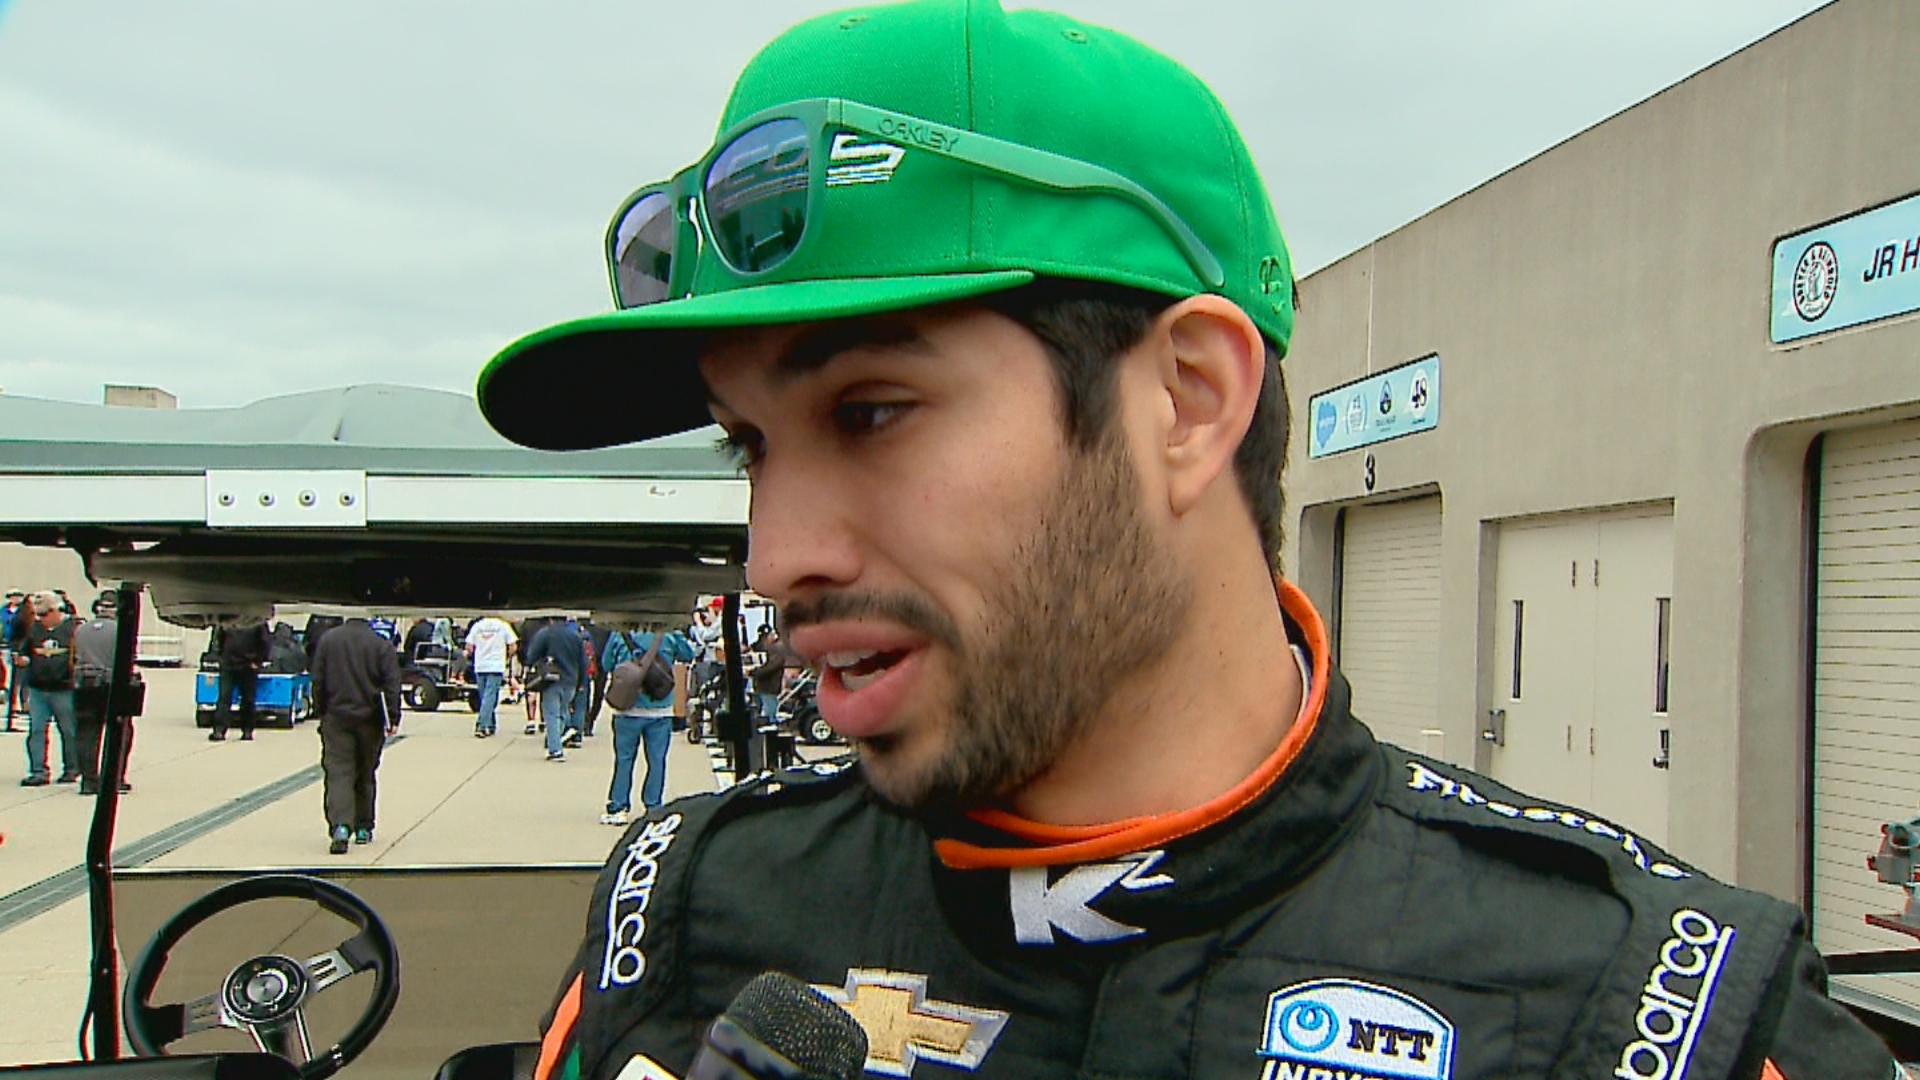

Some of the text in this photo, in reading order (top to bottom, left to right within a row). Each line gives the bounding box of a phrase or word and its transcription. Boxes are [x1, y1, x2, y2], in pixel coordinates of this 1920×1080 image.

[878, 117, 960, 153] OAKLEY
[1863, 243, 1896, 282] JR
[1364, 453, 1375, 491] 3
[603, 813, 683, 988] sparco
[1347, 1018, 1434, 1061] NTT
